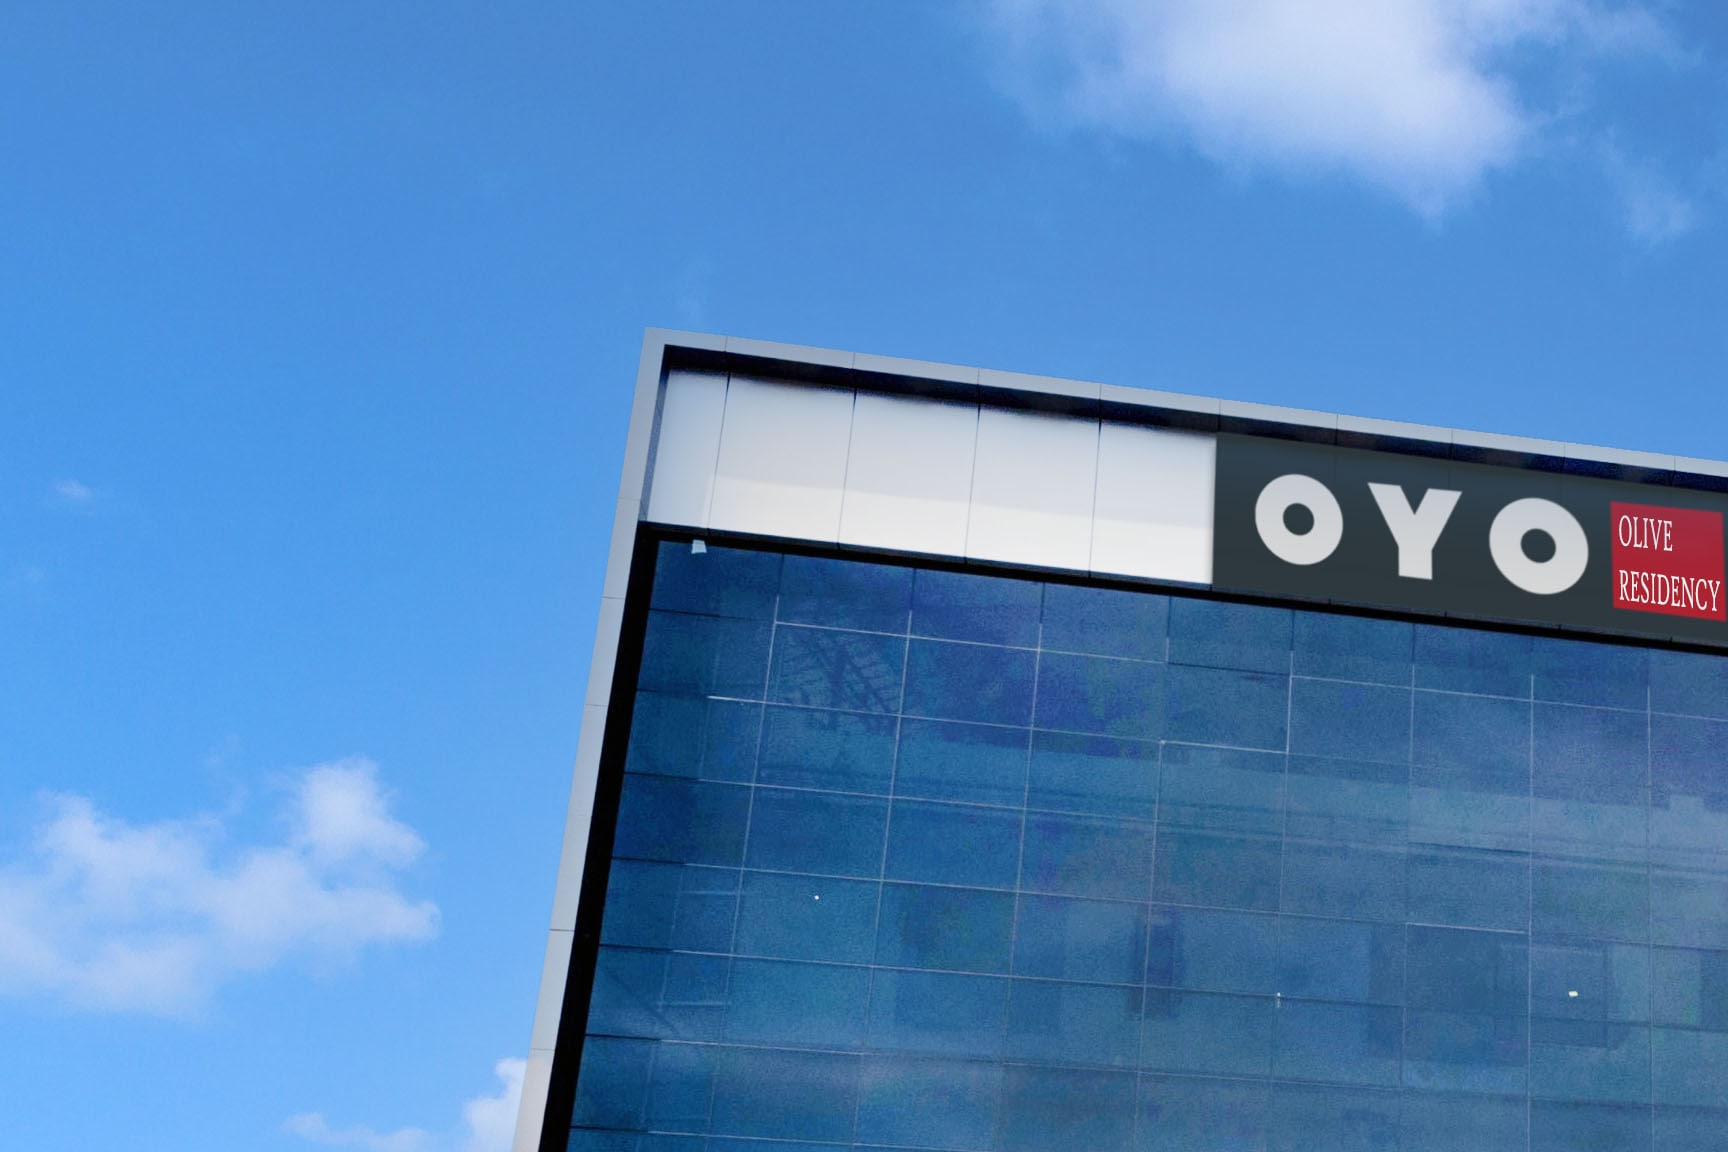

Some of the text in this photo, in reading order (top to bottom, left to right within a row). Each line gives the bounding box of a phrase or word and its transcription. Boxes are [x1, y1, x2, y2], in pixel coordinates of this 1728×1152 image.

[1255, 474, 1589, 595] OYO
[1618, 515, 1673, 552] OLIVE
[1618, 569, 1721, 612] RESIDENCY
